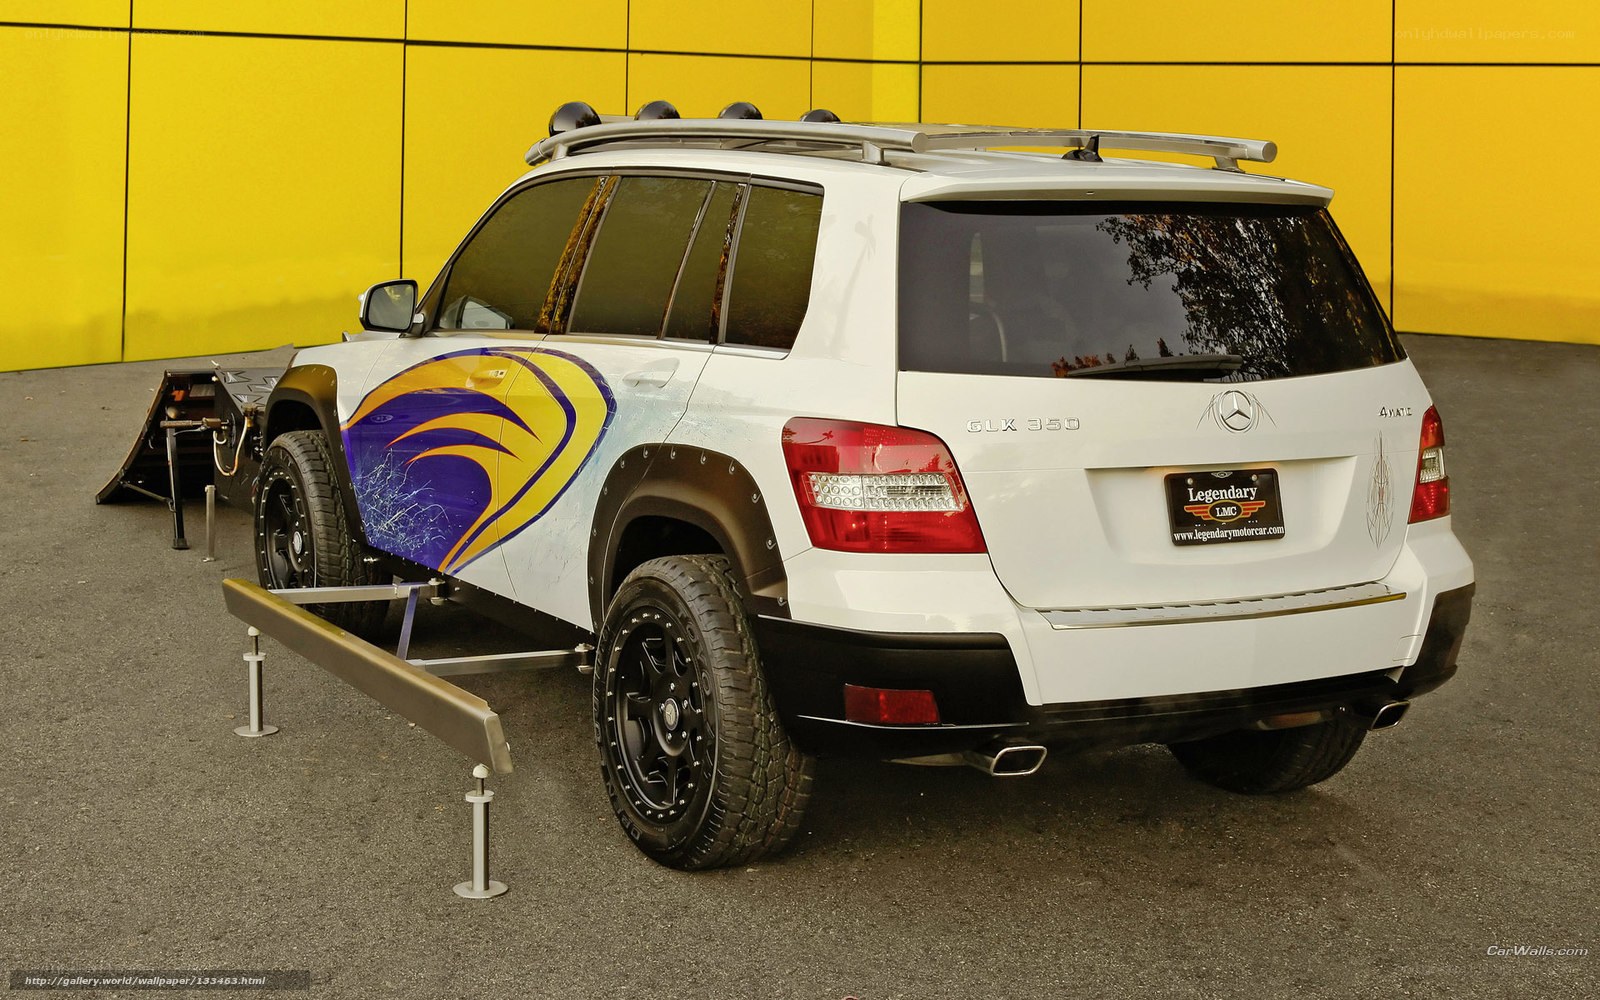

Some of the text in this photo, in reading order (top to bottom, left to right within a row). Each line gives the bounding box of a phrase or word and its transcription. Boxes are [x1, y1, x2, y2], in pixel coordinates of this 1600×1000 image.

[966, 417, 1080, 433] GLK 350
[1188, 485, 1257, 503] Legendary
[1215, 506, 1237, 517] LMC
[1173, 525, 1284, 542] www.legendarymotorcar.com
